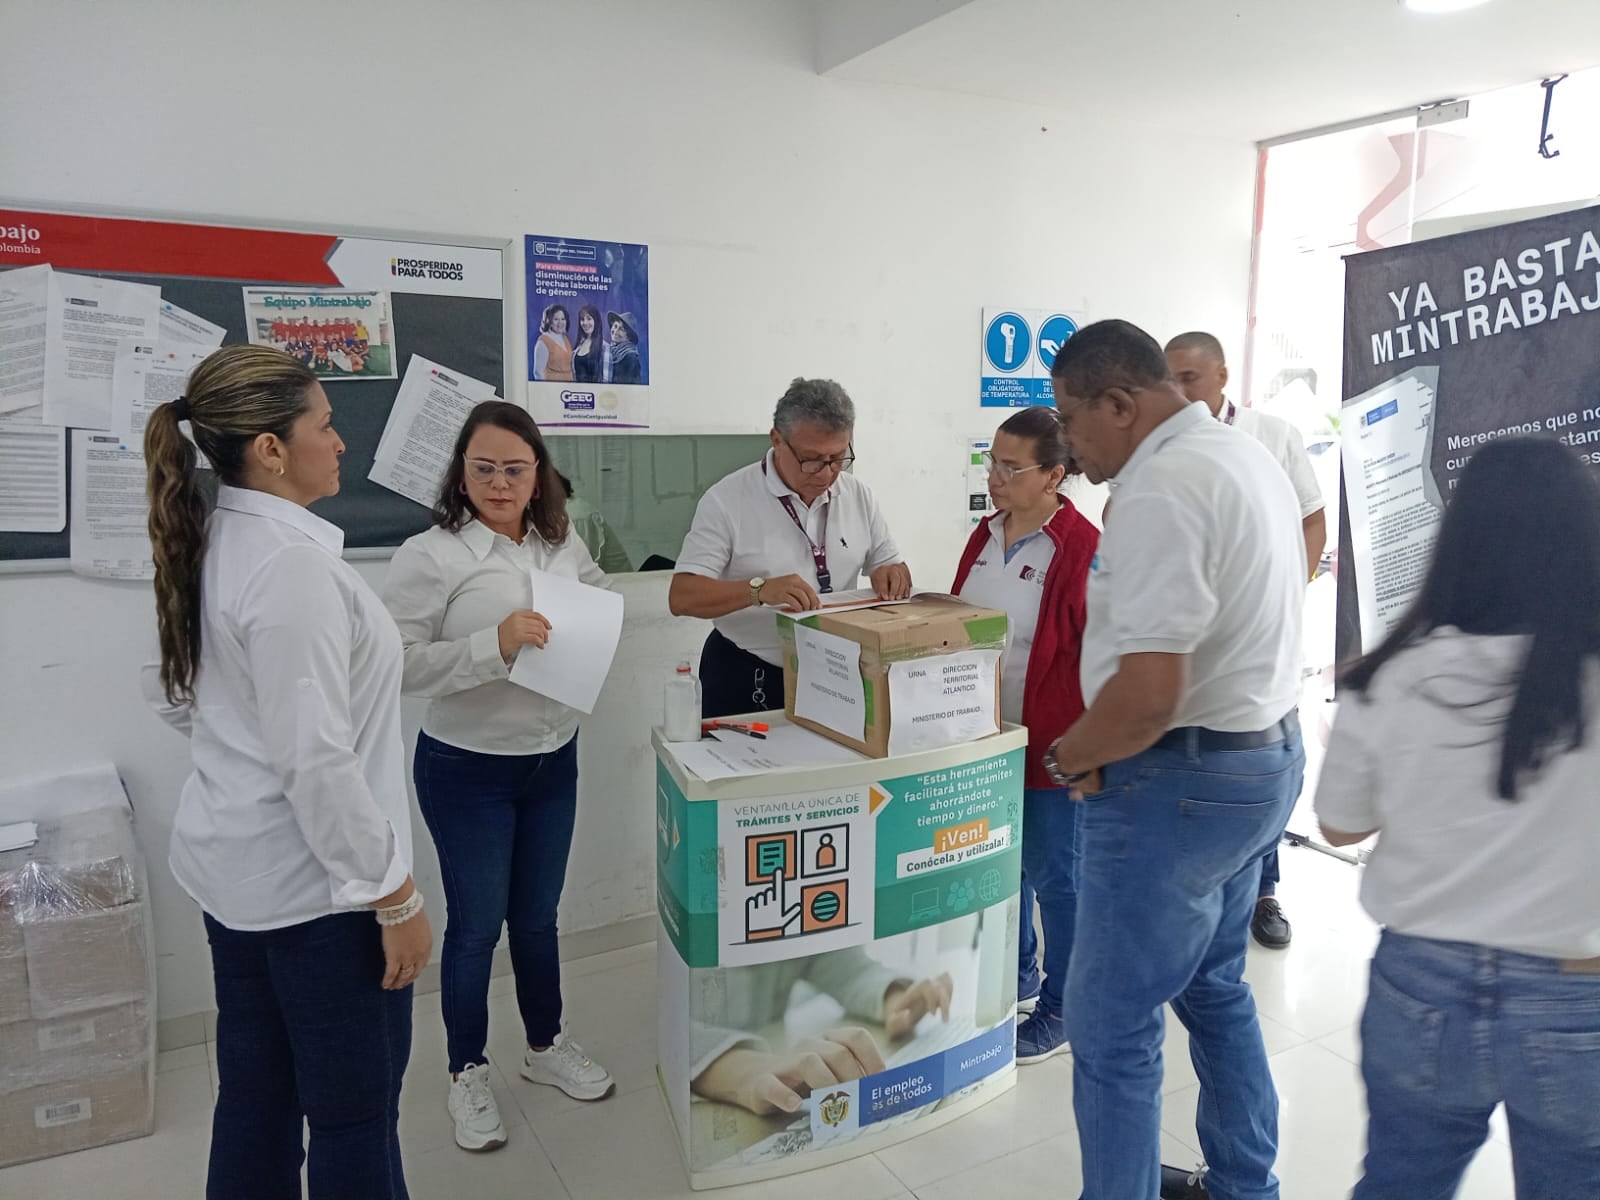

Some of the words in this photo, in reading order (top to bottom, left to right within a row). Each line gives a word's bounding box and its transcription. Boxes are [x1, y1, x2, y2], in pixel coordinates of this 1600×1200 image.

[397, 258, 463, 271] PROSPERIDAD
[398, 267, 425, 278] PARA
[428, 270, 463, 280] TODOS
[1388, 282, 1438, 321] YA
[1463, 230, 1600, 301] BASTA
[536, 271, 587, 281] disminución
[589, 274, 599, 282] de
[601, 275, 612, 283] las
[536, 279, 569, 288] brechas
[570, 281, 608, 291] laborales
[548, 287, 577, 296] género
[264, 296, 306, 310] Equipo
[309, 296, 371, 310] Mintrabajo
[1447, 421, 1541, 451] Merecemos
[1546, 411, 1577, 432] que
[908, 670, 927, 679] URNA
[942, 663, 977, 674] DIRECCION
[943, 674, 979, 684] TERRITORIAL
[943, 684, 976, 695] ATLANTICO
[912, 712, 947, 724] MINISTERIO
[947, 710, 955, 718] DE
[956, 706, 981, 716] TRABAJO
[950, 758, 1008, 780] herramienta
[904, 783, 955, 803] facilitará
[957, 780, 974, 791] tus
[976, 769, 1013, 786] trámites
[734, 801, 805, 816] VENTANILLA
[845, 793, 861, 804] DE
[930, 788, 992, 811] ahorrándote
[736, 814, 791, 828] TRÁMITES
[795, 813, 802, 821] Y
[806, 805, 860, 820] SERVICIOS
[917, 811, 955, 827] tiempo
[957, 810, 964, 819] y
[941, 823, 984, 852] ¡Ven!
[906, 853, 955, 872] Conócela
[957, 852, 964, 862] y
[966, 837, 1005, 857] utilízala!
[960, 1044, 1003, 1073] Mintrabajo
[871, 1087, 882, 1100] El
[884, 1075, 924, 1096] empleo
[886, 1094, 901, 1107] de
[903, 1083, 933, 1101] todos
